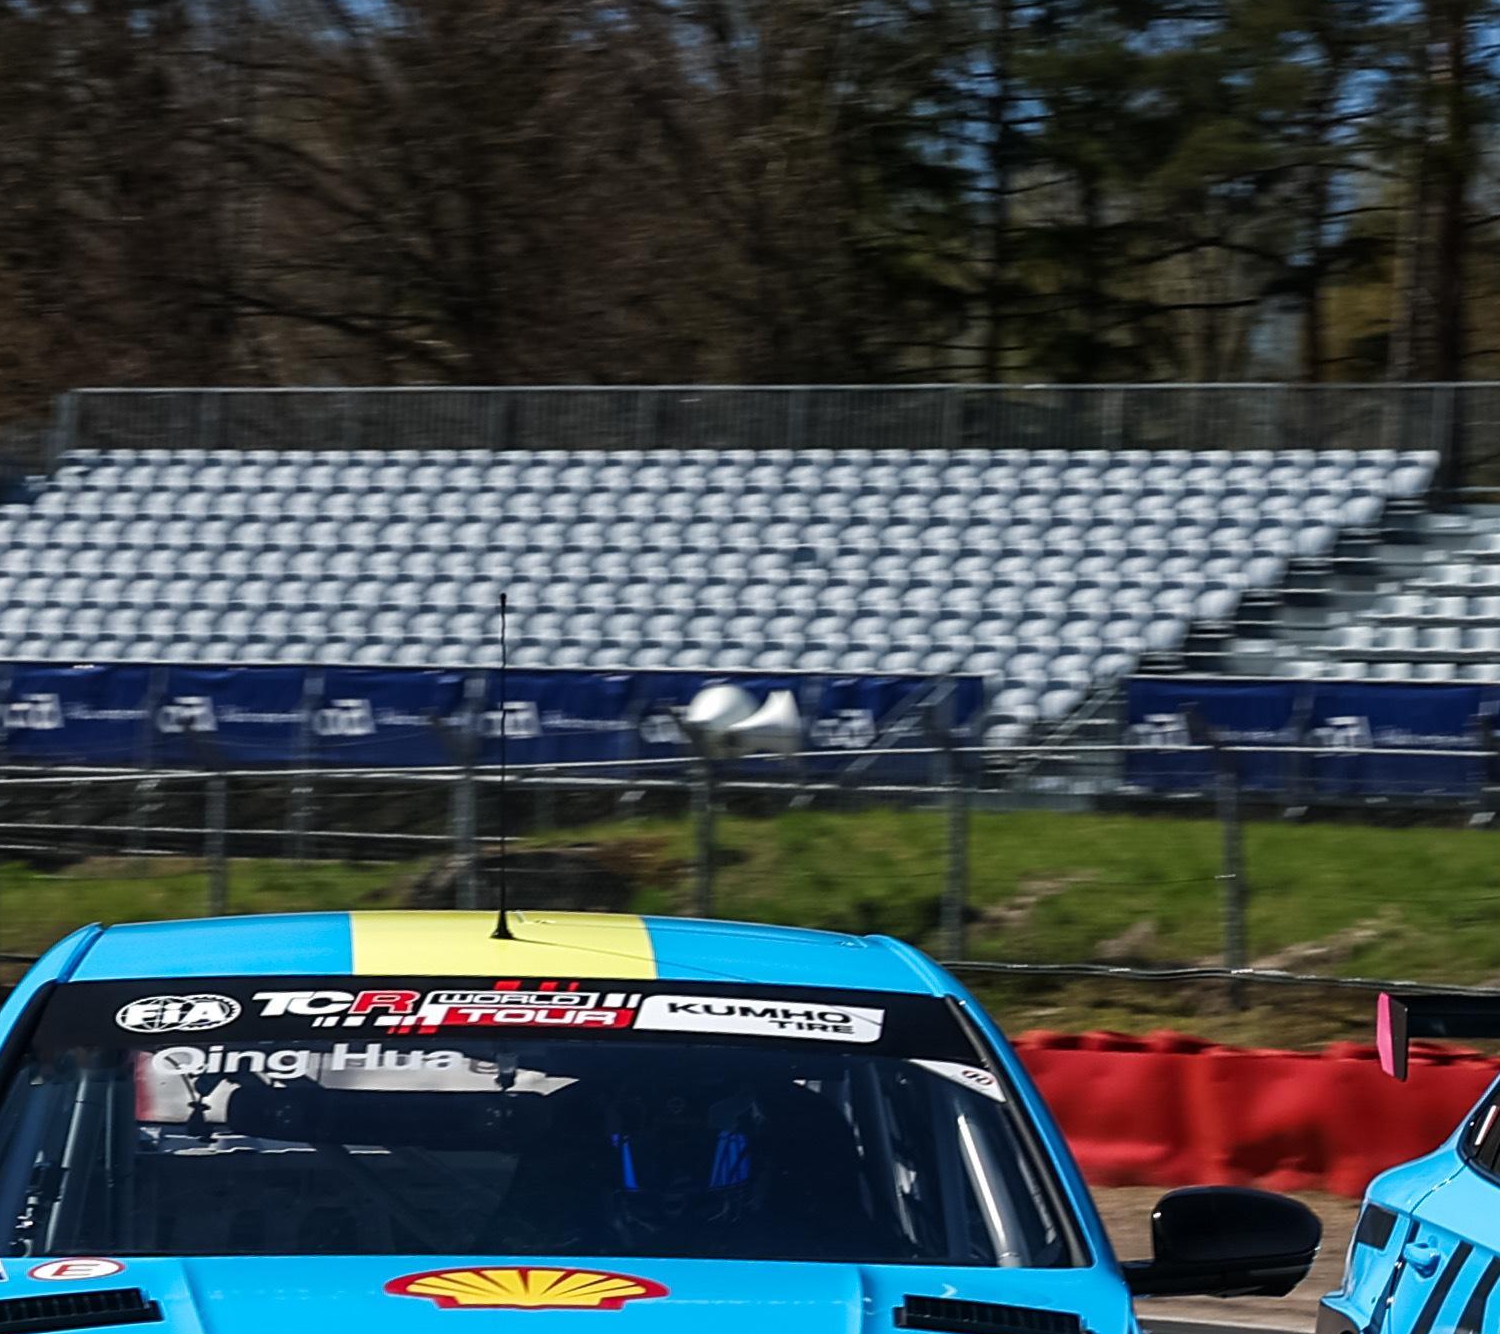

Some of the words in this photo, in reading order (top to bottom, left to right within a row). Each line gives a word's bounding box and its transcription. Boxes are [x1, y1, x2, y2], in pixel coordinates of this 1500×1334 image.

[252, 990, 421, 1015] TCR
[437, 993, 581, 1005] WORLD
[123, 1000, 227, 1027] FIA
[457, 1009, 618, 1025] TOUR
[668, 1003, 852, 1024] KUMHO
[767, 1020, 855, 1035] TIRE
[151, 1044, 310, 1079] Qing
[332, 1043, 464, 1072] Hua
[52, 1263, 101, 1277] E
